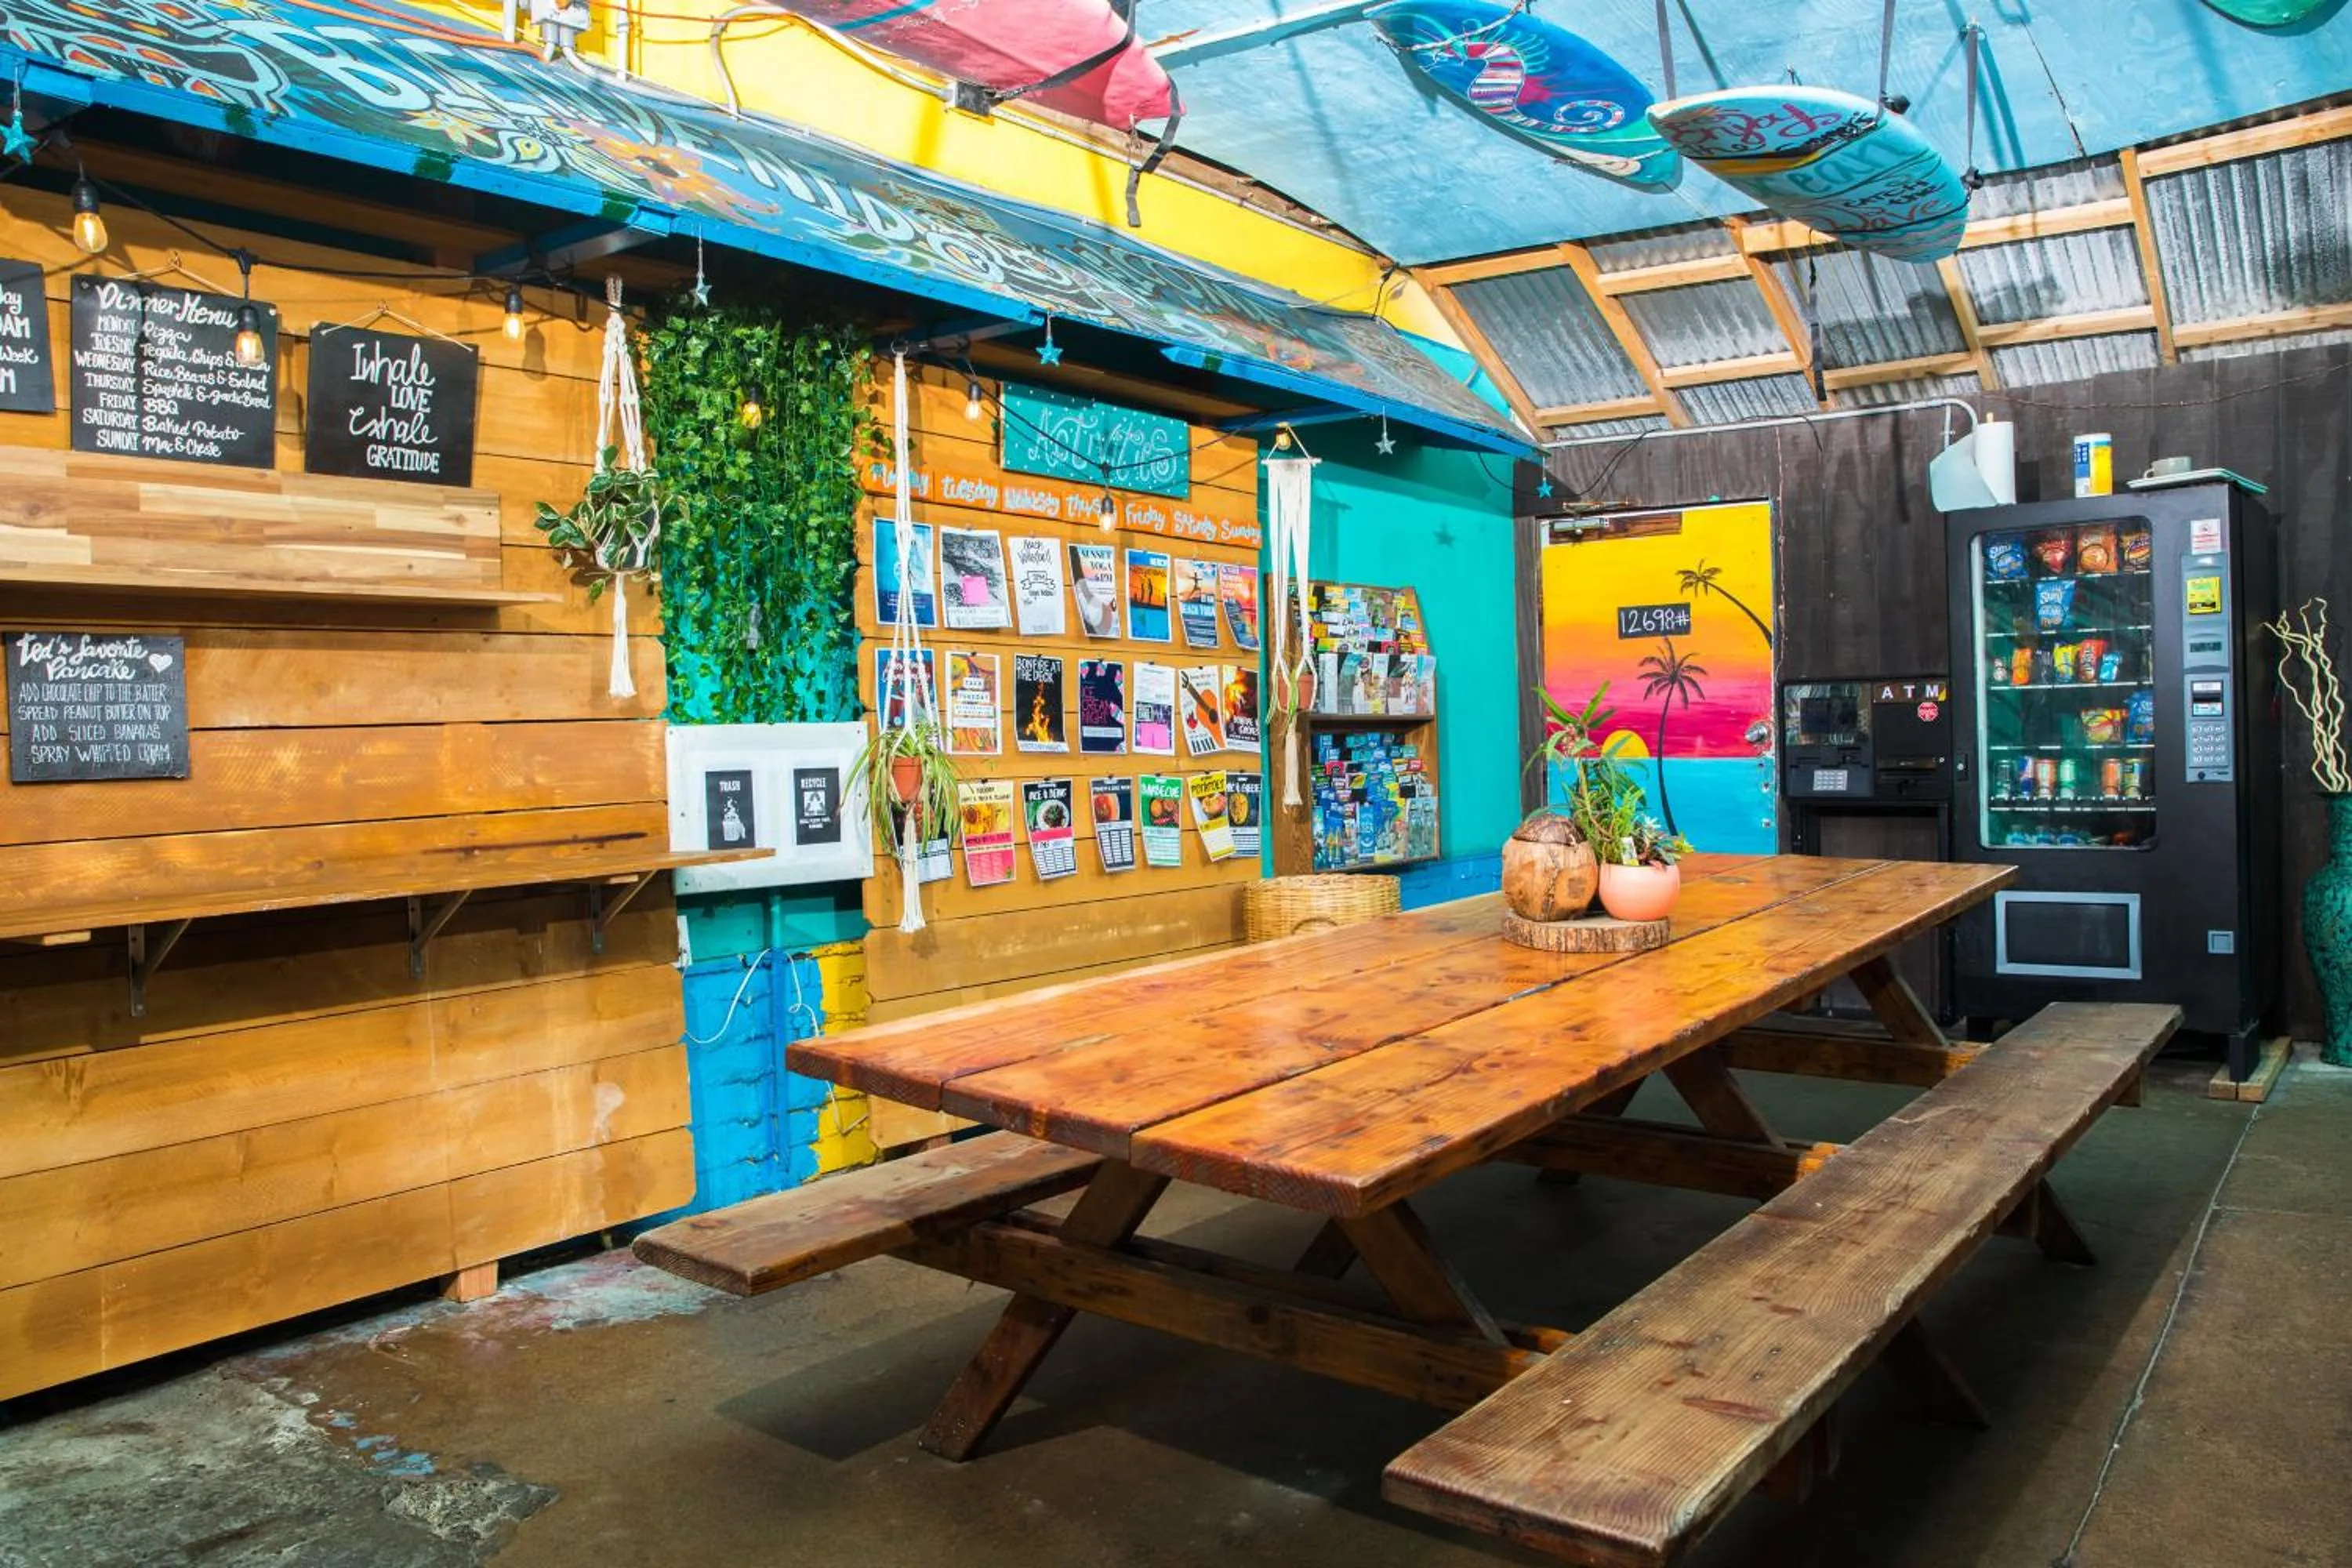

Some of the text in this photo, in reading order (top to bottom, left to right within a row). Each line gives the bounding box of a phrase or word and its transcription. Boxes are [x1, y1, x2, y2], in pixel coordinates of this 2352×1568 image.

[96, 282, 238, 328] Dinner Menu
[97, 315, 192, 345] MONDAY Pizza
[90, 332, 136, 357] TUESDAY
[75, 350, 136, 374] WEDNESDAY
[350, 340, 436, 387] Inhale
[85, 372, 136, 393] THURSDAY
[100, 392, 179, 416] FRIDAY BBQ
[390, 385, 433, 413] LOVE
[83, 408, 137, 430] SATURDAY
[349, 406, 437, 445] Exhale
[96, 430, 140, 452] SUNDAY
[366, 444, 440, 474] GRATITUDE
[1621, 608, 1690, 633] 12698#
[46, 657, 136, 681] Pancake
[1016, 658, 1061, 672] BONFIRE AT
[19, 682, 39, 703] ADD
[18, 706, 58, 721] SPREAD
[64, 705, 102, 720] PEANUT
[31, 724, 161, 742] ADD SLICED BANANAS
[30, 744, 70, 764] SPRAY
[77, 744, 131, 763] WHIPPED
[719, 780, 741, 792] TRASH
[800, 777, 826, 789] RECYCLE
